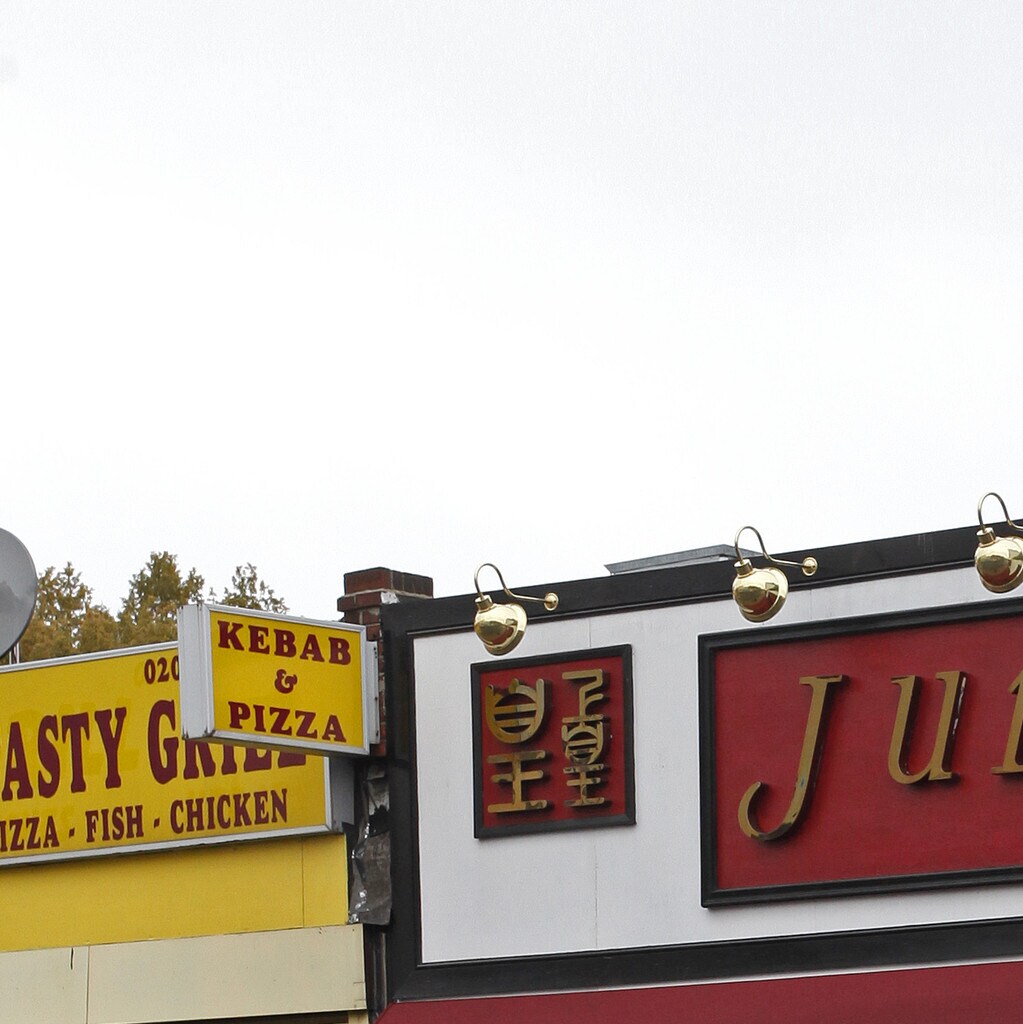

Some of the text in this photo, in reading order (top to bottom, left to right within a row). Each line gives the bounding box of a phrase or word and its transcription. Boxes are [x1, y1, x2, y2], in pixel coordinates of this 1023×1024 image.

[217, 620, 351, 665] KEBAB
[144, 655, 180, 684] 020
[274, 669, 297, 693] &
[229, 702, 346, 742] PIZZA
[85, 805, 144, 842] FISH
[170, 789, 287, 833] CHICKEN
